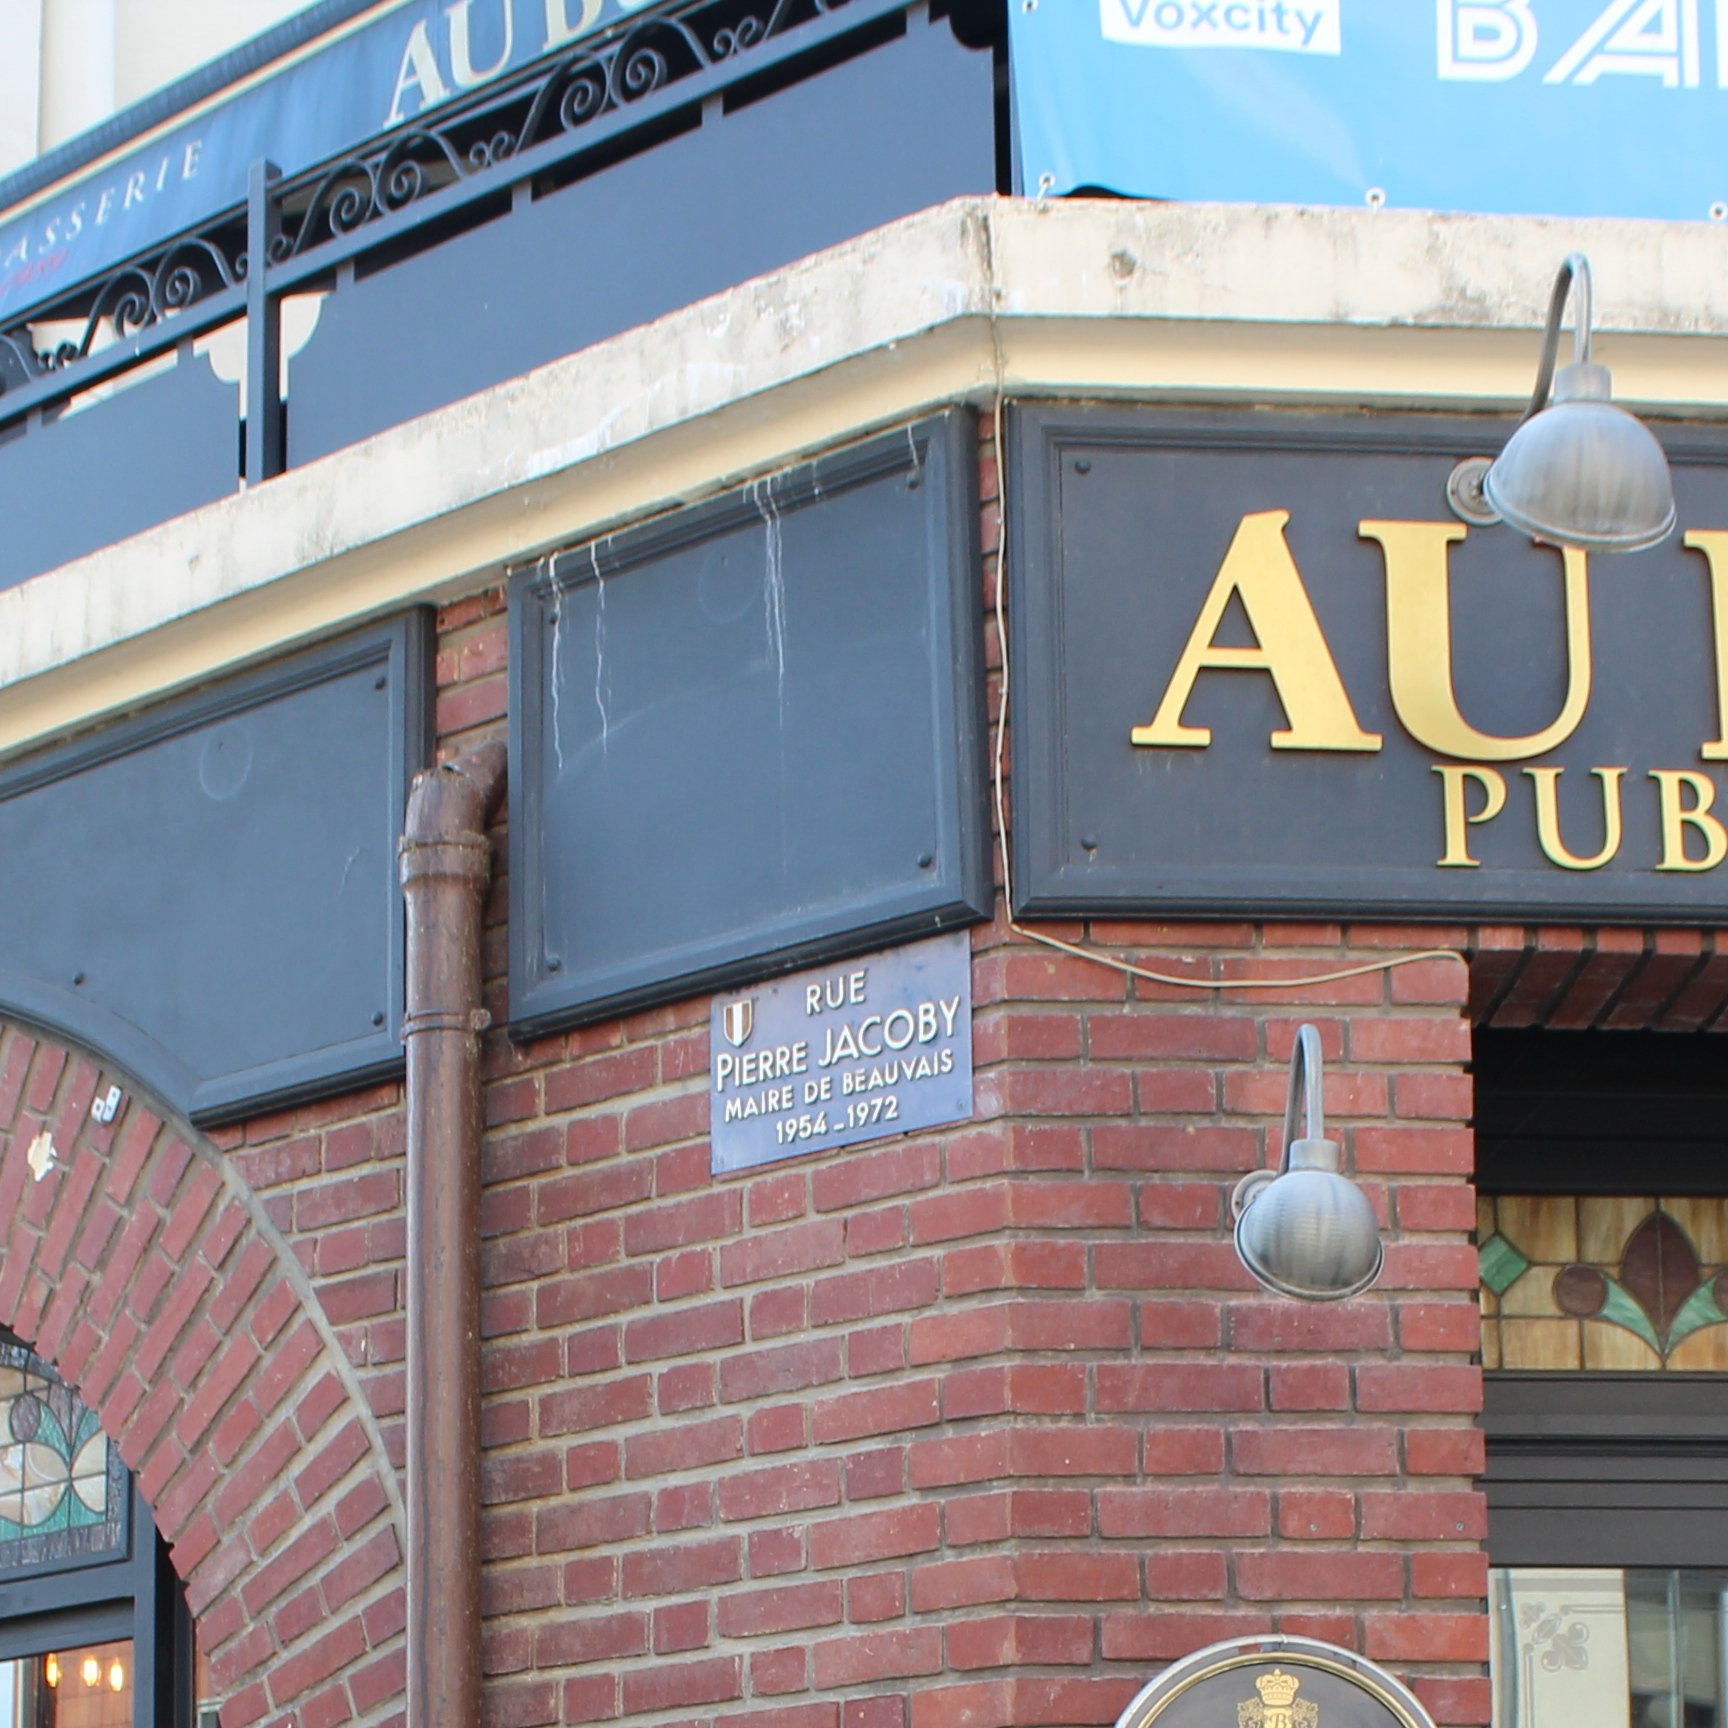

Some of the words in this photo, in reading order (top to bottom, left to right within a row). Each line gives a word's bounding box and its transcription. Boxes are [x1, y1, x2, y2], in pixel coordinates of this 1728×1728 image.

[1121, 0, 1324, 47] Voxcity
[1129, 510, 1593, 761] AU
[805, 969, 867, 1016] RUE
[716, 1040, 809, 1093] PIERRE
[818, 995, 961, 1068] JACOBY
[724, 1084, 794, 1123] MAIRE
[804, 1076, 833, 1106] DE
[842, 1048, 954, 1097] BEAUVAIS
